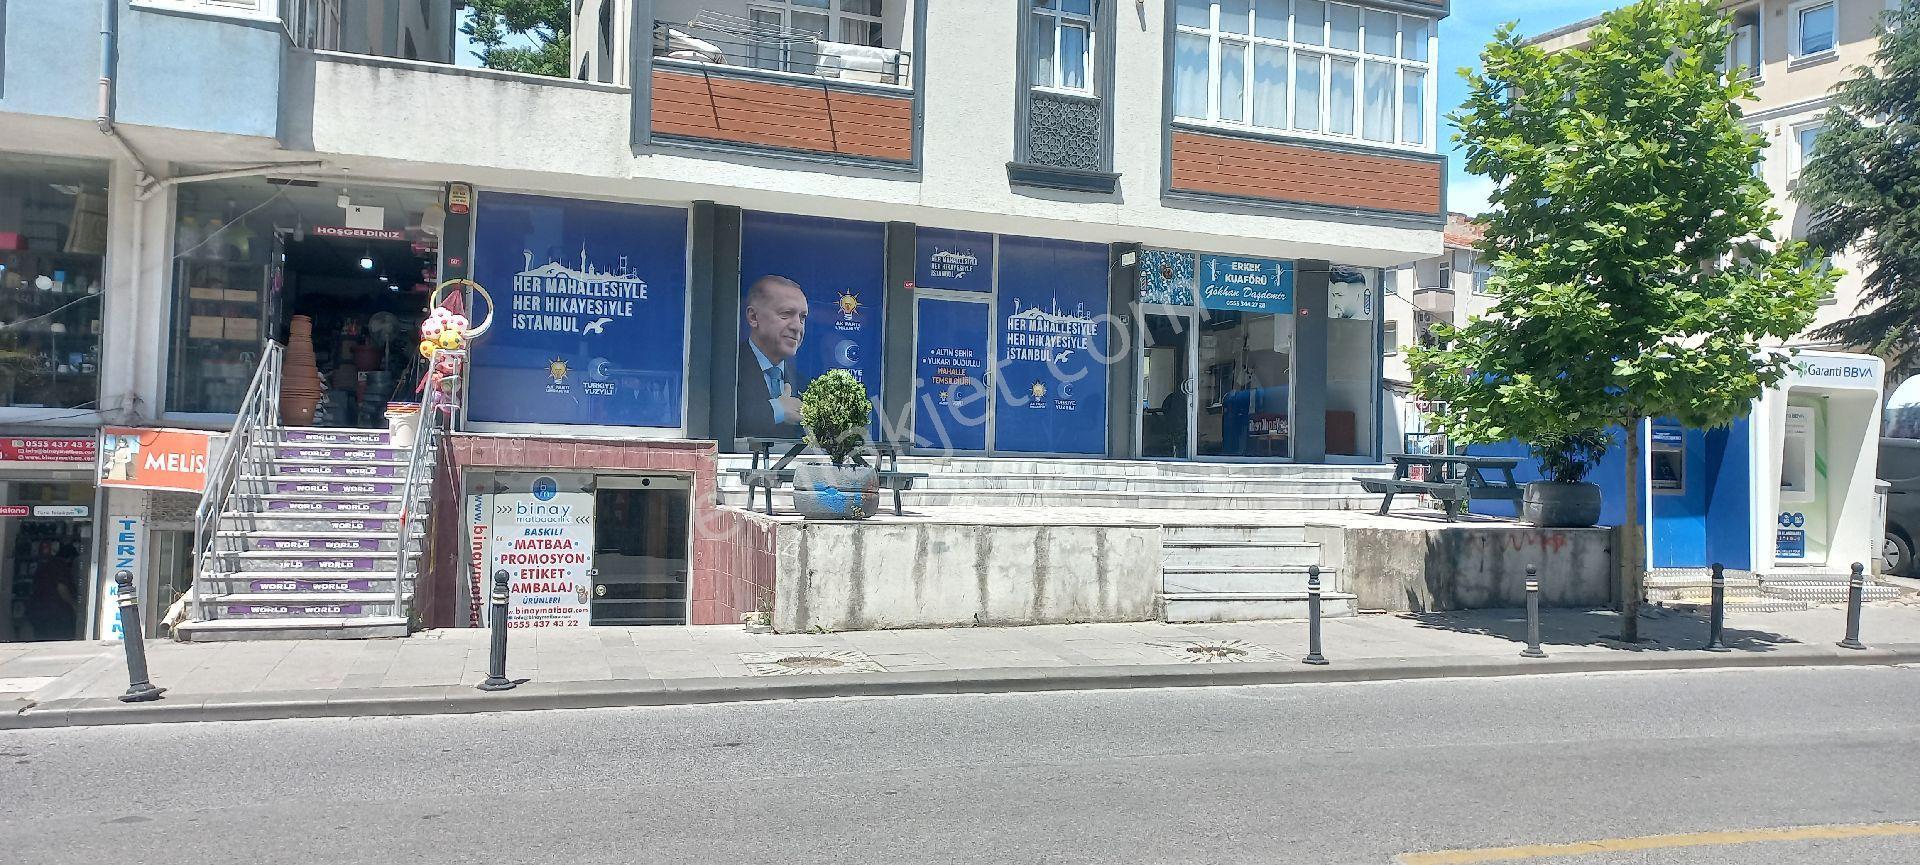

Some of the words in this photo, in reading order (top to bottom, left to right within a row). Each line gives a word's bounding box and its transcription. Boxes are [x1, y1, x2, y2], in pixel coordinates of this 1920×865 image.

[1232, 261, 1262, 272] ERKEK
[513, 275, 541, 292] HER
[1224, 273, 1268, 285] KUAFÖRÜ
[1205, 284, 1240, 298] Gökhan
[512, 294, 541, 311] HER
[1007, 317, 1026, 331] HER
[1007, 333, 1026, 346] HER
[1808, 364, 1842, 376] Garanti
[1843, 366, 1873, 378] BBVA
[25, 440, 49, 448] 0555
[517, 501, 571, 518] binay
[524, 528, 564, 537] BASKILI
[115, 519, 137, 568] TERZ
[514, 538, 573, 550] MATBAA
[500, 553, 585, 565] PROMOSYON
[520, 565, 565, 580] ETİKET
[511, 581, 573, 594] AMBALAJ
[507, 620, 530, 629] 0555
[533, 620, 550, 628] 437
